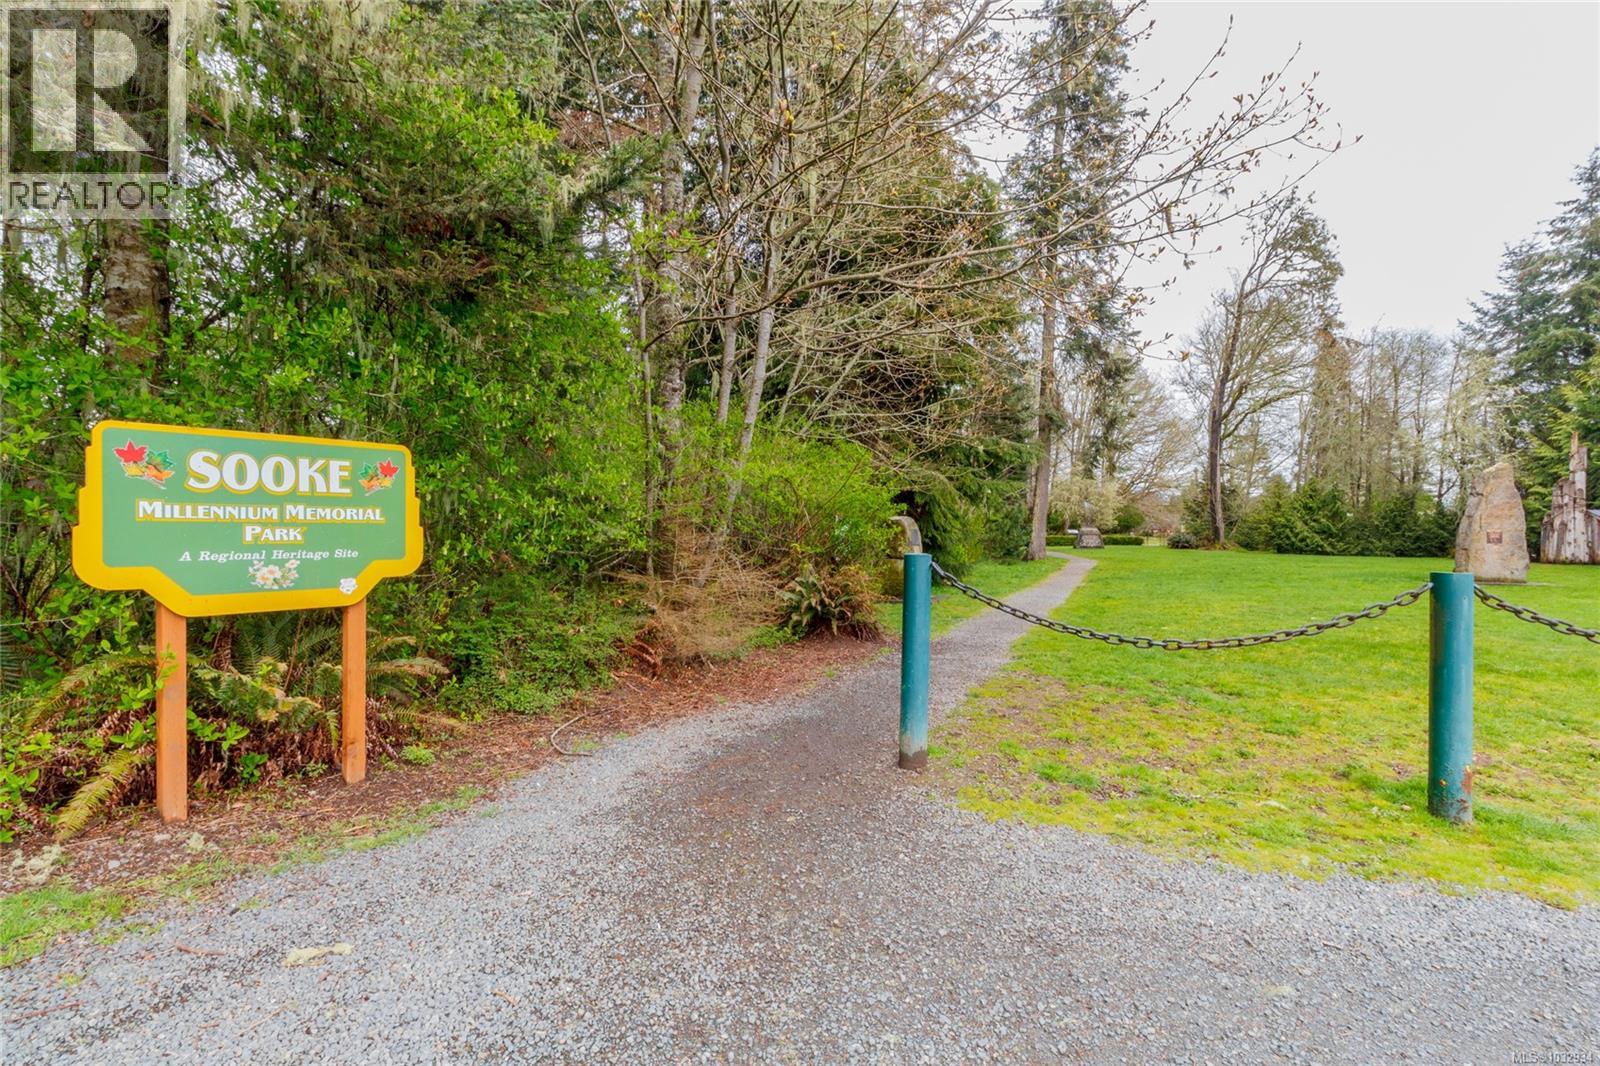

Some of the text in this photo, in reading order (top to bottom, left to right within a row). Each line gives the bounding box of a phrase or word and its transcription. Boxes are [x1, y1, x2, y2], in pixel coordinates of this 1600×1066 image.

[186, 450, 352, 495] SOOKE
[137, 500, 385, 522] MILLENNIUM MEMORIAL
[244, 525, 305, 543] PARK
[178, 548, 359, 563] A Regional Heritage Site
